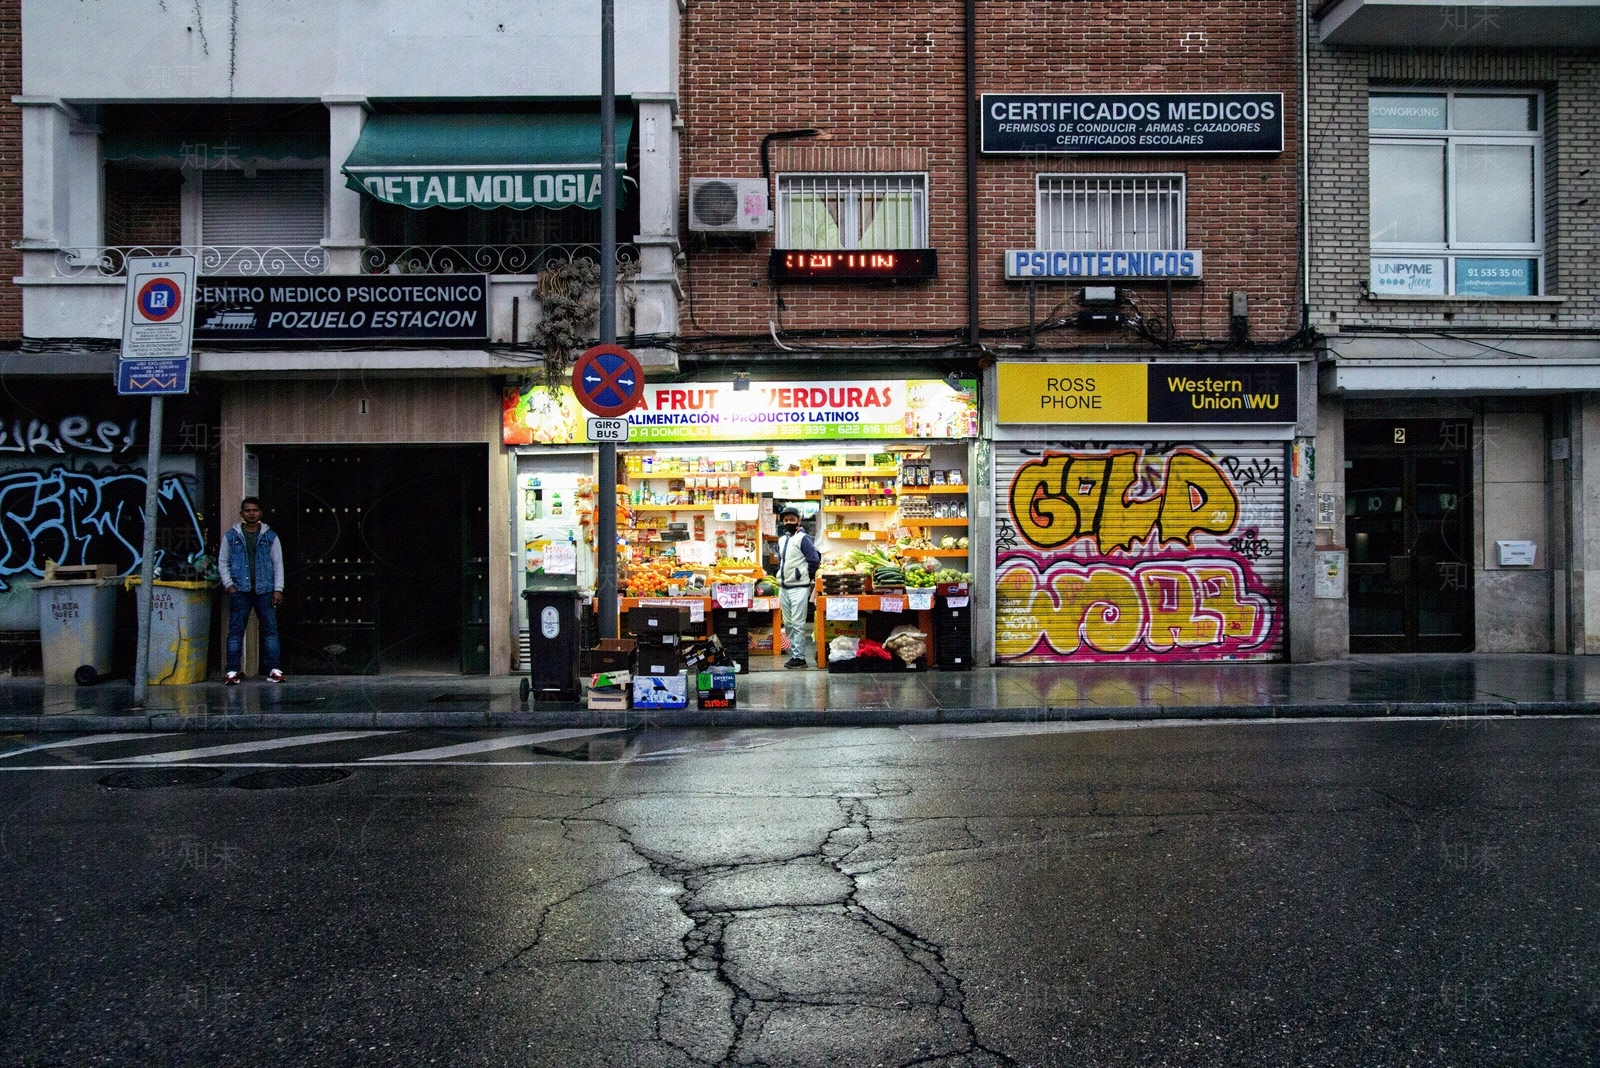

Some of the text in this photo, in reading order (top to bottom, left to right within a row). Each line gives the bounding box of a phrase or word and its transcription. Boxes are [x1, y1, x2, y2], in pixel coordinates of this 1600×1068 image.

[990, 101, 1275, 120] CERTIFICADOS MEDICOS
[1371, 107, 1440, 117] COWORKING
[999, 123, 1056, 133] PERMISOS
[1058, 123, 1074, 132] DE
[1076, 123, 1136, 133] CONDUCIR
[1145, 123, 1185, 132] ARMAS
[1193, 122, 1261, 132] CAZADORES
[1056, 135, 1204, 145] CERTIFICADOS ESCOLARES
[1015, 251, 1195, 276] PSICOTECNICOS
[1378, 263, 1432, 275] UNIPYME
[1467, 268, 1523, 277] 91 535 35 00
[193, 285, 482, 303] CENTRO MEDICO PSICOTECNICO
[267, 310, 477, 329] POZUELO ESTACION
[1046, 377, 1096, 392] ROSS
[1167, 376, 1242, 393] Western
[361, 400, 367, 414] 1
[630, 394, 649, 411] A
[1040, 394, 1102, 410] PHONE
[1191, 393, 1242, 410] Union
[628, 410, 719, 425] ALIMENTACIÓN
[732, 412, 806, 423] PRODUCTOS
[808, 411, 860, 422] LATINOS
[595, 421, 621, 430] GIRO
[651, 426, 708, 437] DOMICILIO
[805, 425, 826, 435] 339
[838, 424, 860, 434] 622
[863, 424, 881, 434] 816
[597, 430, 619, 439] BUS
[1395, 429, 1405, 442] 2
